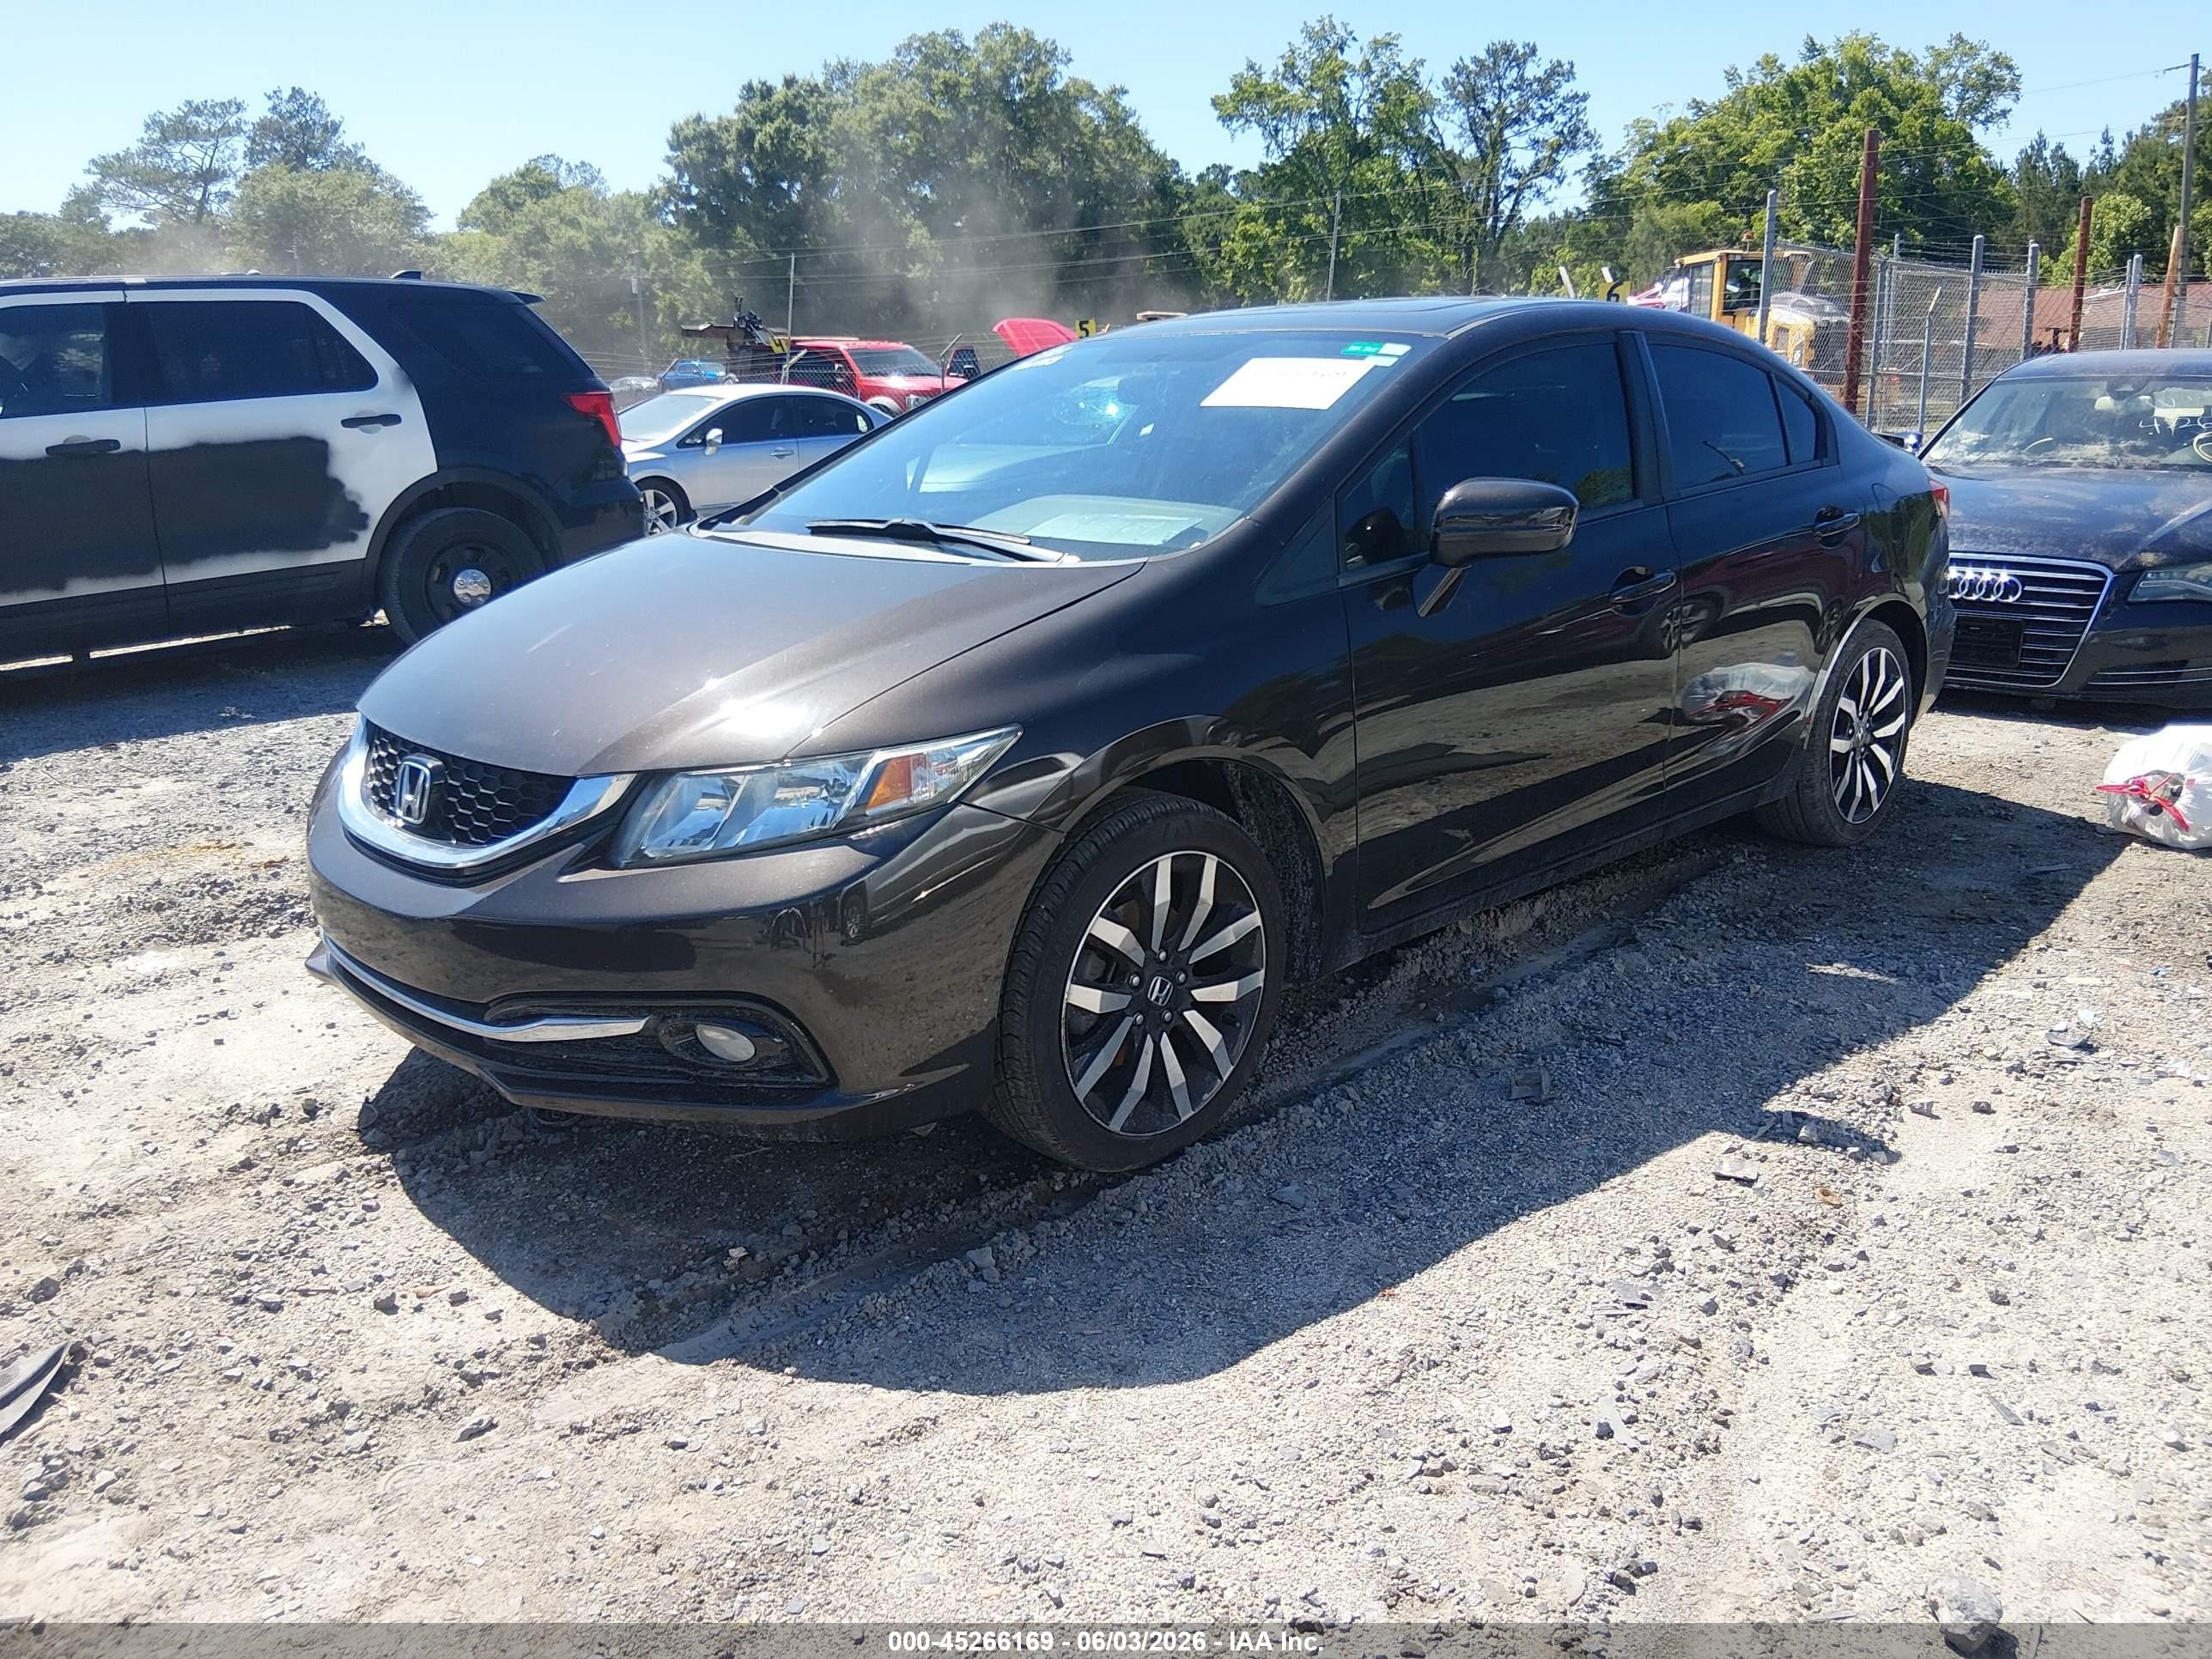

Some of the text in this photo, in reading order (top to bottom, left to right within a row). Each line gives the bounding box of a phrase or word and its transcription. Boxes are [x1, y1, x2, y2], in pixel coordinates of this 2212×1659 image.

[1607, 281, 1623, 302] 6
[1079, 319, 1090, 339] 5
[773, 337, 785, 353] 4
